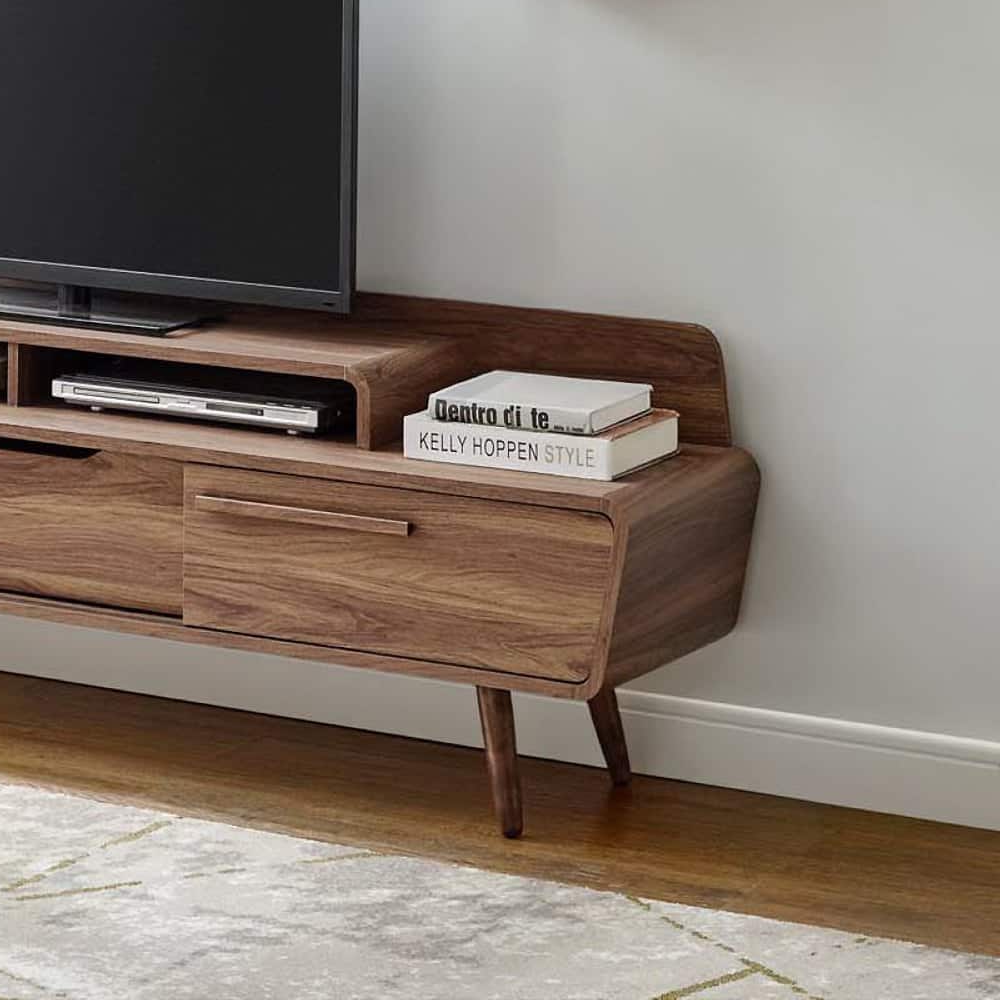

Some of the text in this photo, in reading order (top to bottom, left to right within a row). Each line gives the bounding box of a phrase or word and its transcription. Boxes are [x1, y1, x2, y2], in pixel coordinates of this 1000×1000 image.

[435, 399, 549, 429] Dentro di te
[419, 432, 595, 468] KELLY HOPPEN STYLE
